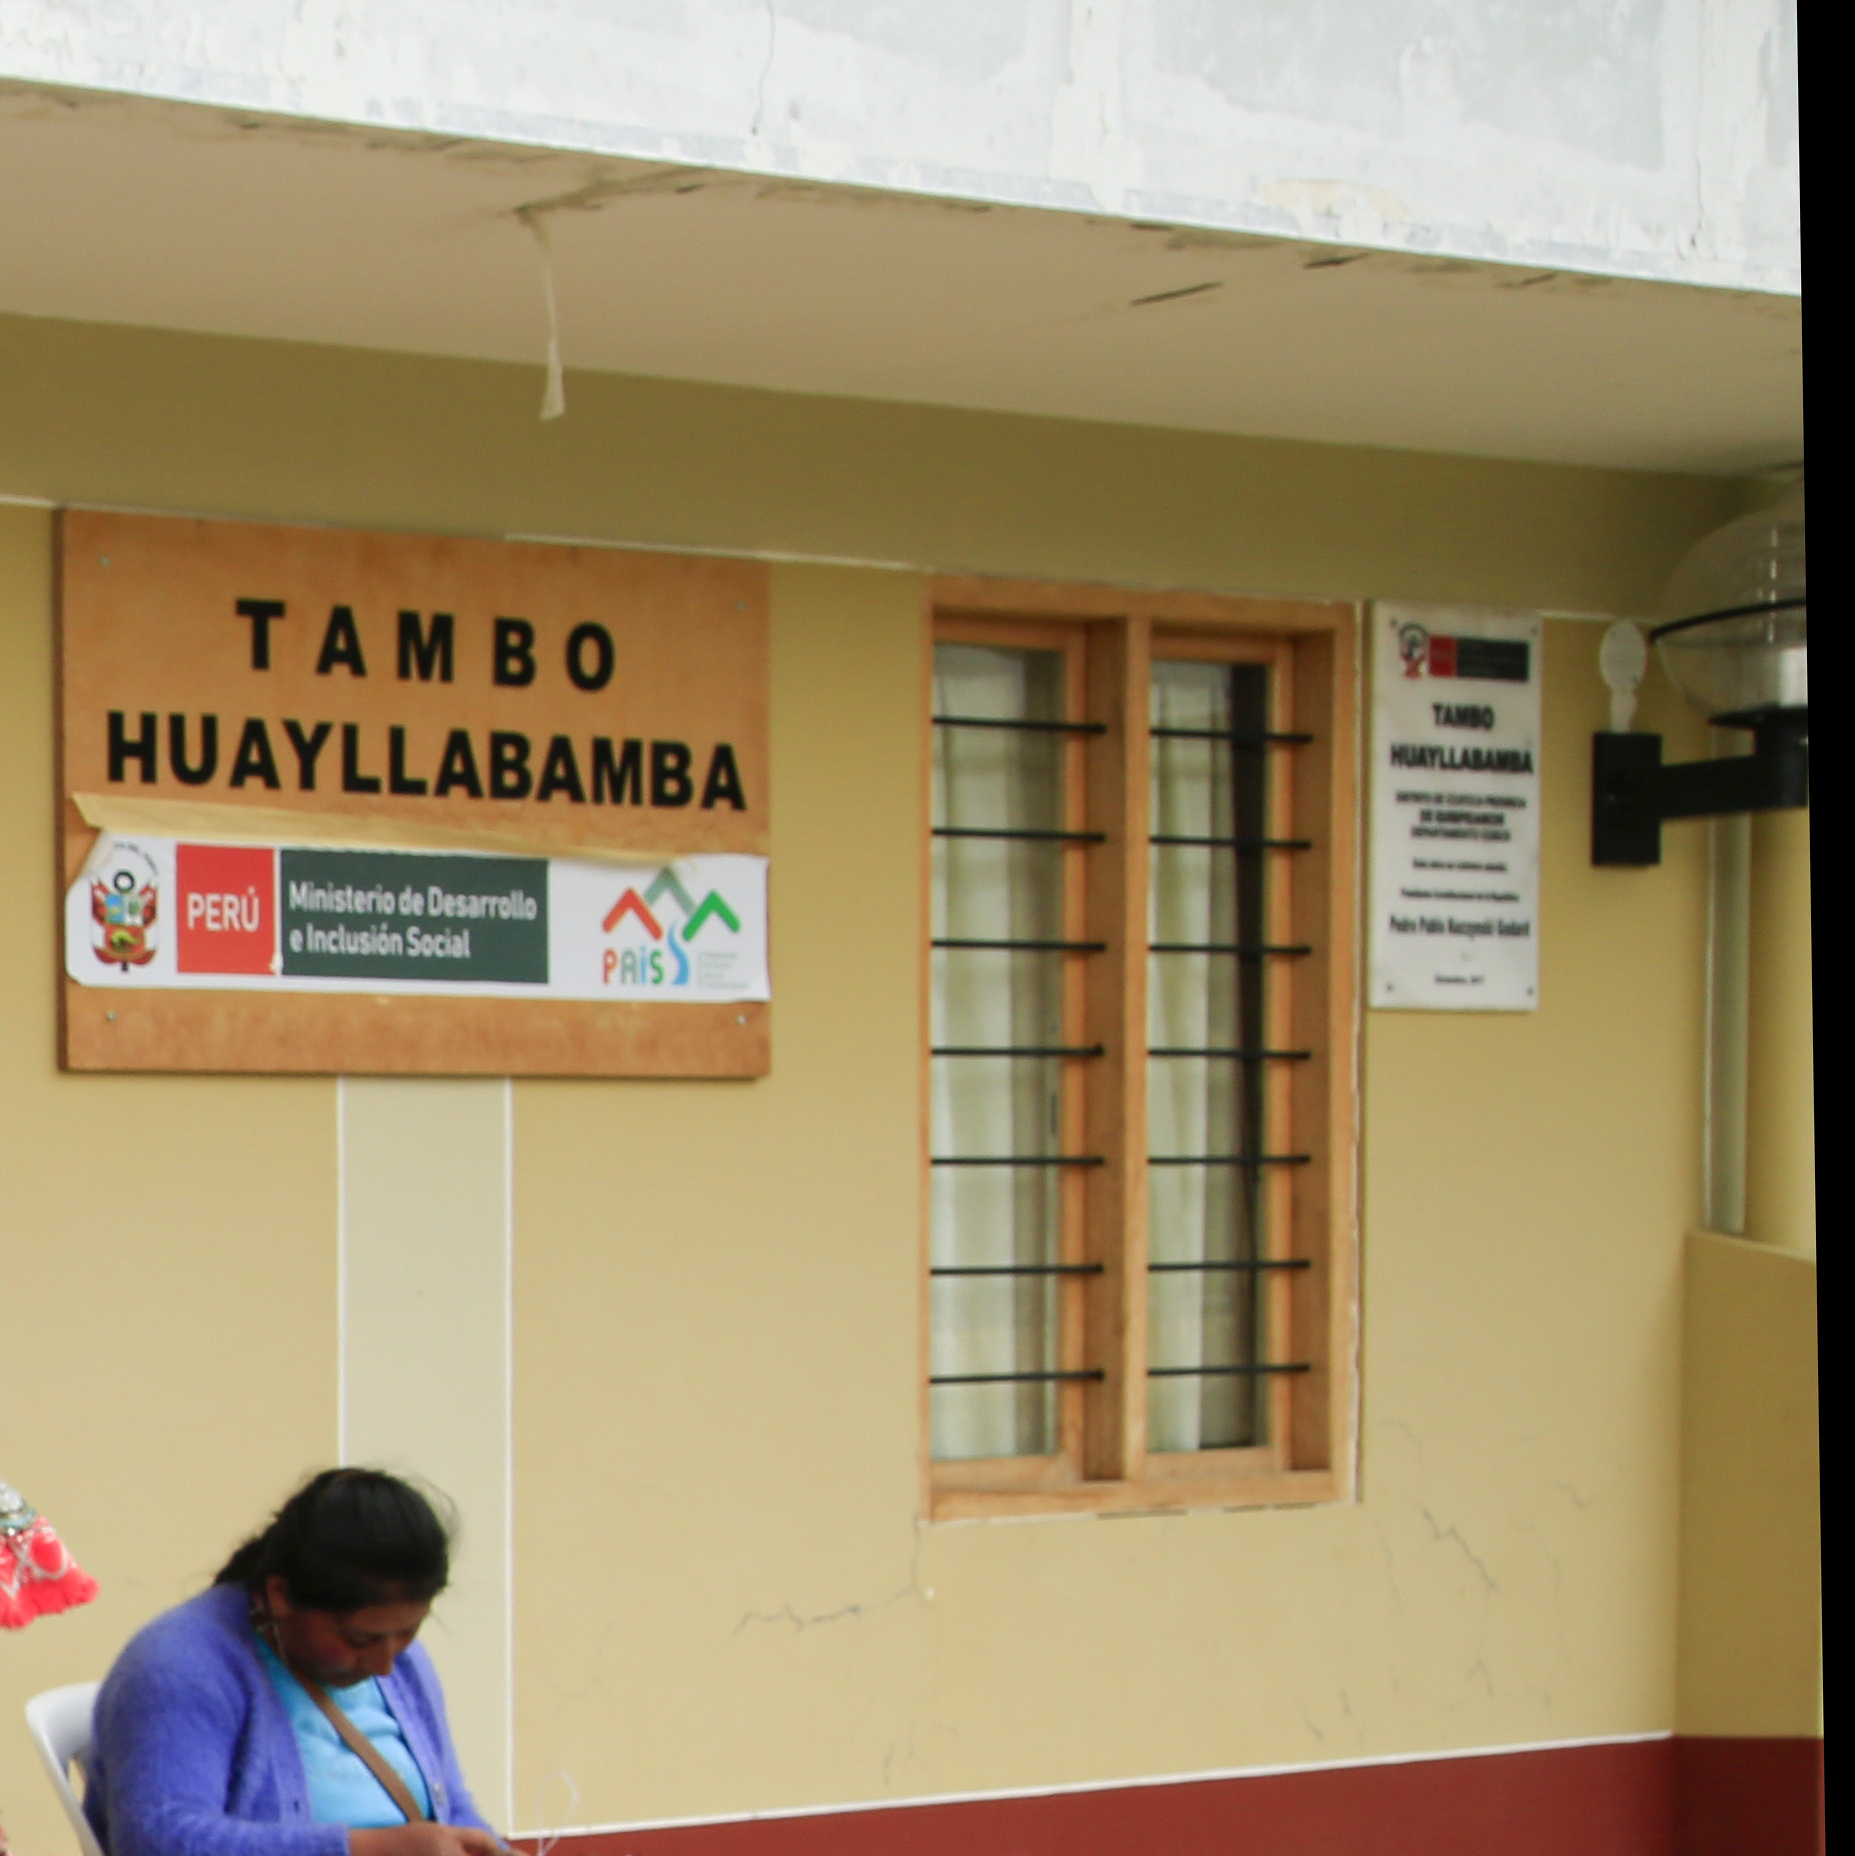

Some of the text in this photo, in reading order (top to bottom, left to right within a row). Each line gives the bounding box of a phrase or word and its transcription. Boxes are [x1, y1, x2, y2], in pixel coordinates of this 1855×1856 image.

[235, 597, 616, 692] TAMBO
[1432, 702, 1495, 731] TAMBO
[107, 710, 748, 812] HUAYLLABAMBA
[1391, 743, 1534, 775] HUAYLLABAMBA
[187, 886, 260, 932] PERÚ
[289, 880, 538, 920] Ministerio de Desarrollo
[290, 921, 471, 960] e Inclusión Social
